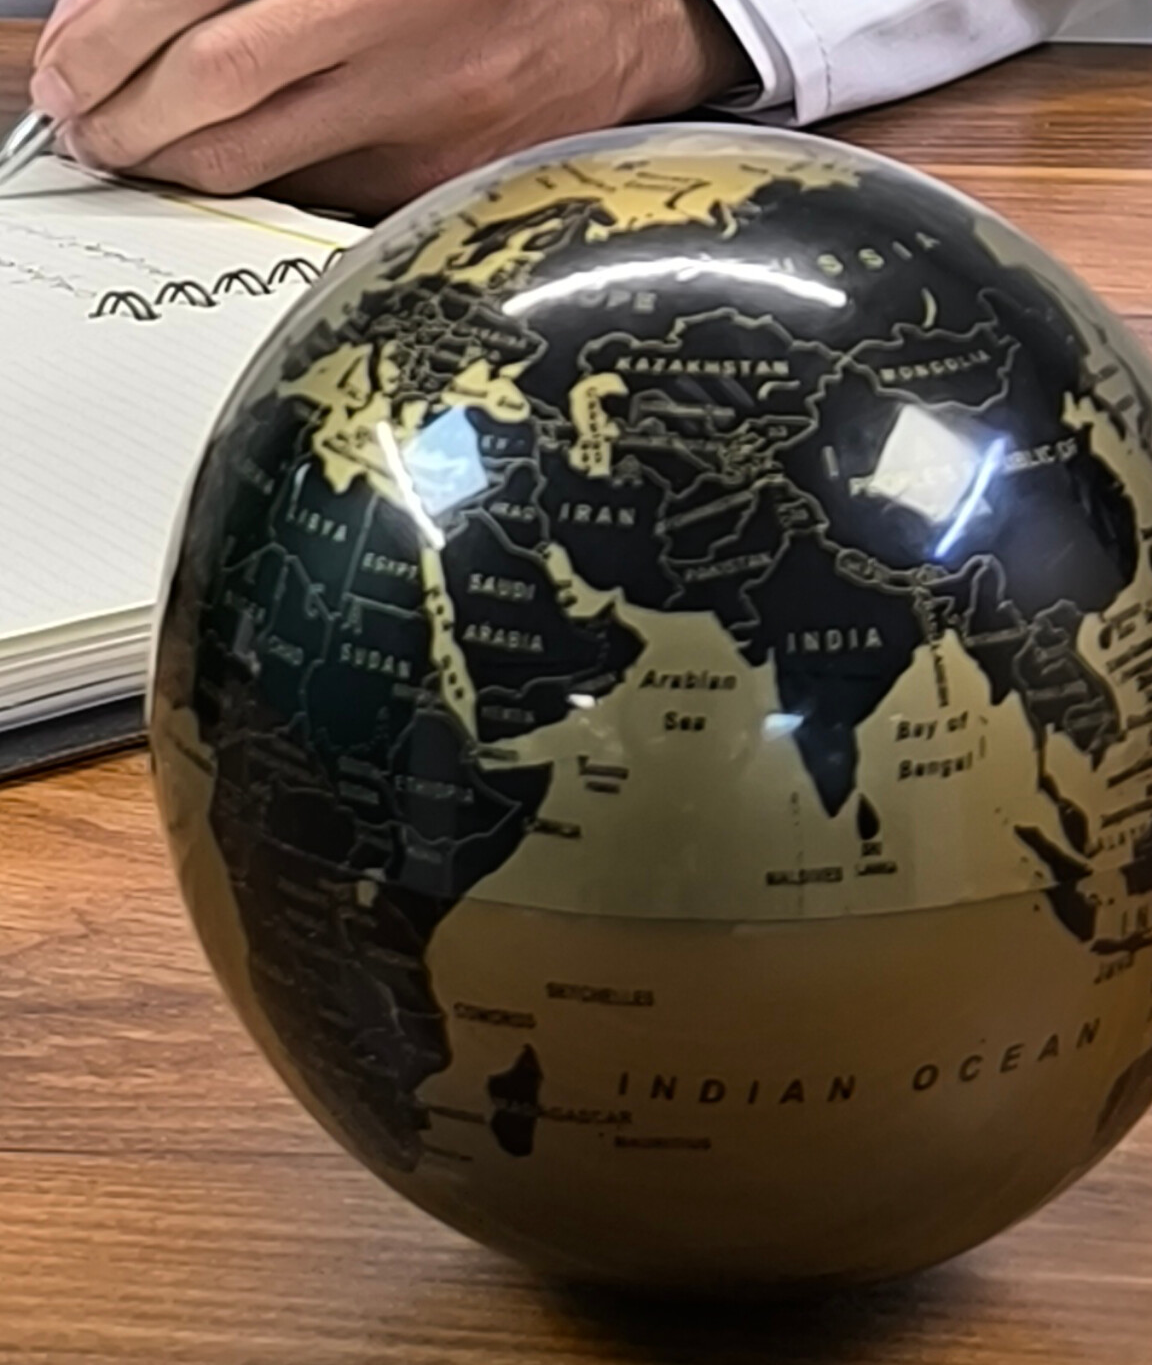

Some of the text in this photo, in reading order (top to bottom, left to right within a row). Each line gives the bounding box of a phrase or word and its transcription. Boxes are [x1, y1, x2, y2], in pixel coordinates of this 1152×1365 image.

[558, 502, 635, 526] IRAN
[462, 623, 544, 653] ARABIA
[786, 626, 884, 654] INDIA
[617, 1017, 1100, 1105] INDIAN OCEAN
